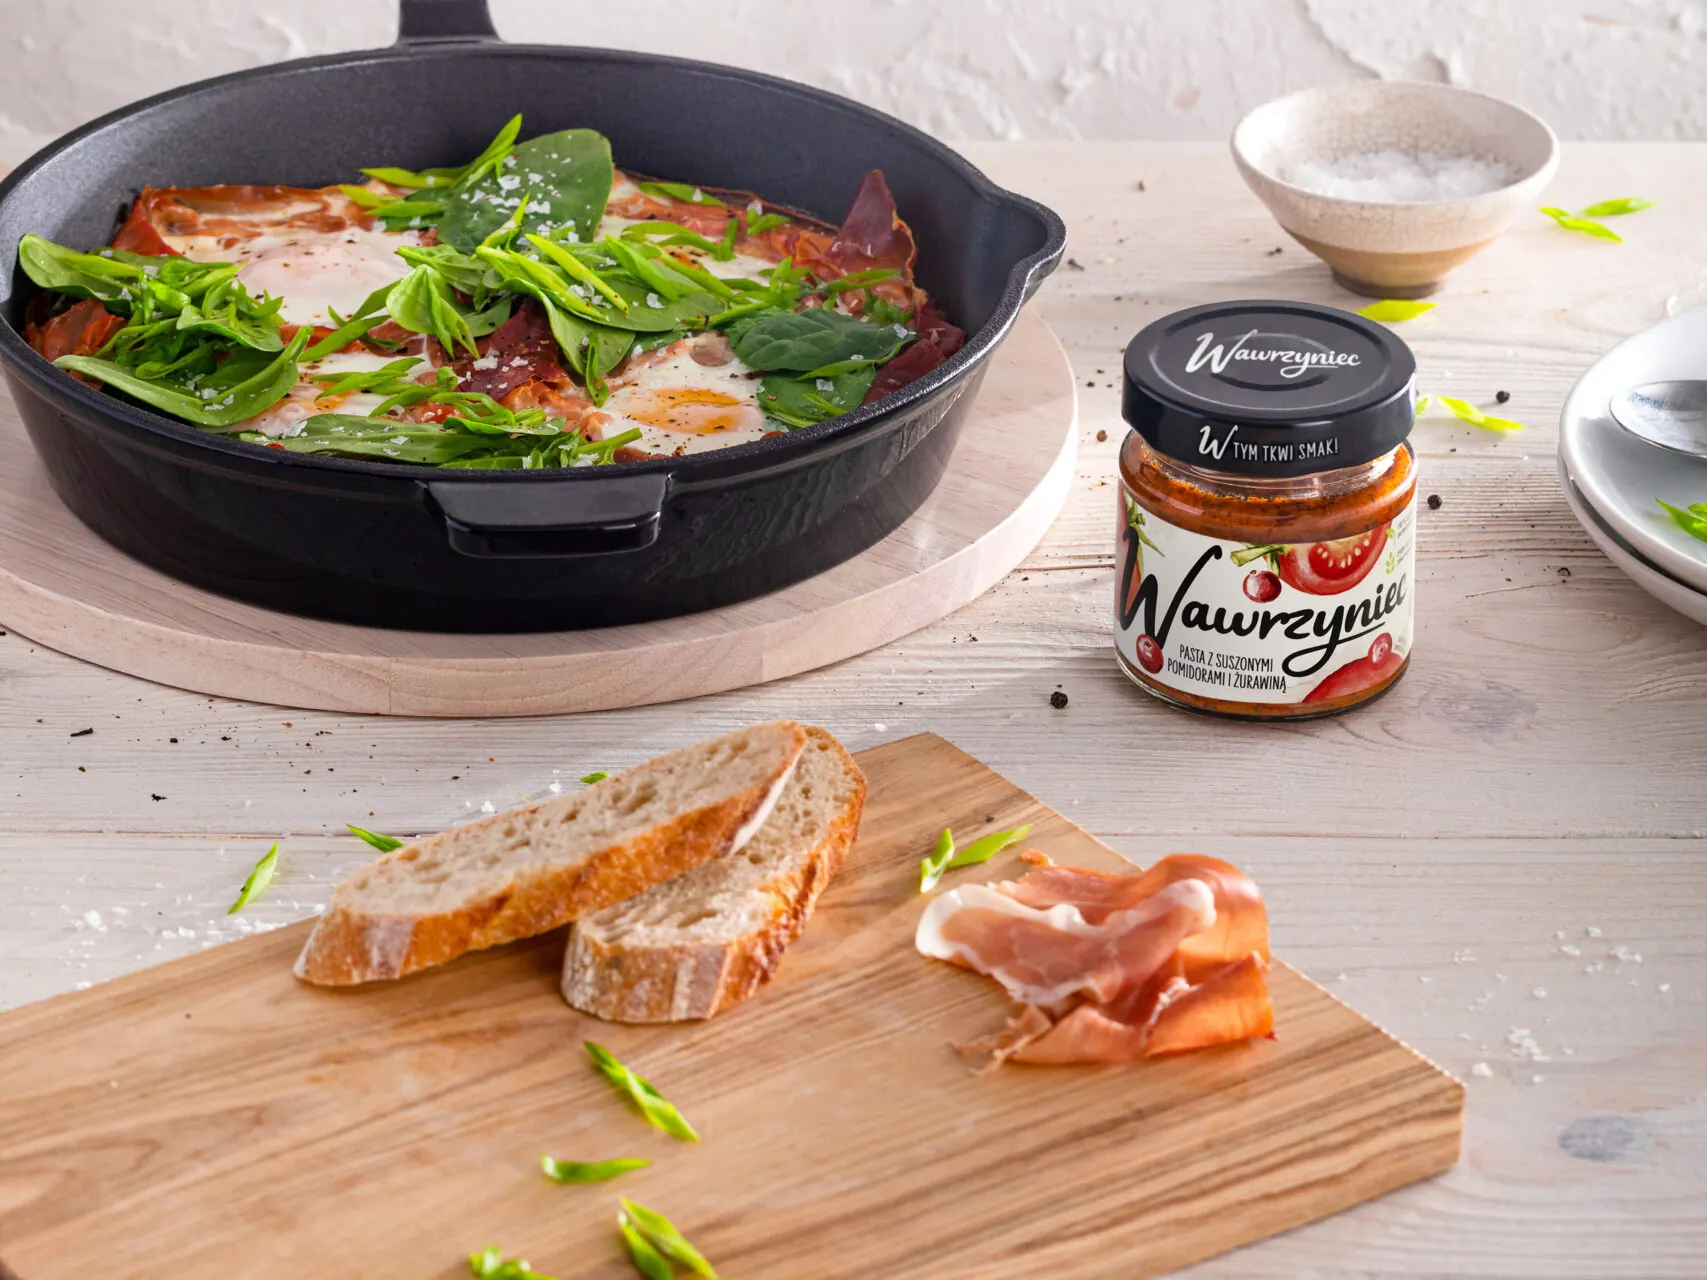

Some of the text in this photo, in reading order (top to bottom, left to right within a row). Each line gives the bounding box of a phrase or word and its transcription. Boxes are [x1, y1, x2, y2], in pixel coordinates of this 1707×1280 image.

[1185, 329, 1361, 378] Wawrzyniec
[1198, 424, 1339, 462] W TYM TKWI SMAK!
[1119, 526, 1407, 676] Wawrzyniec
[1167, 658, 1225, 686] POMIDORAMI
[1233, 671, 1287, 693] ŻURAWINĄ
[1179, 644, 1273, 672] PASTA Z SUSZONYMI
